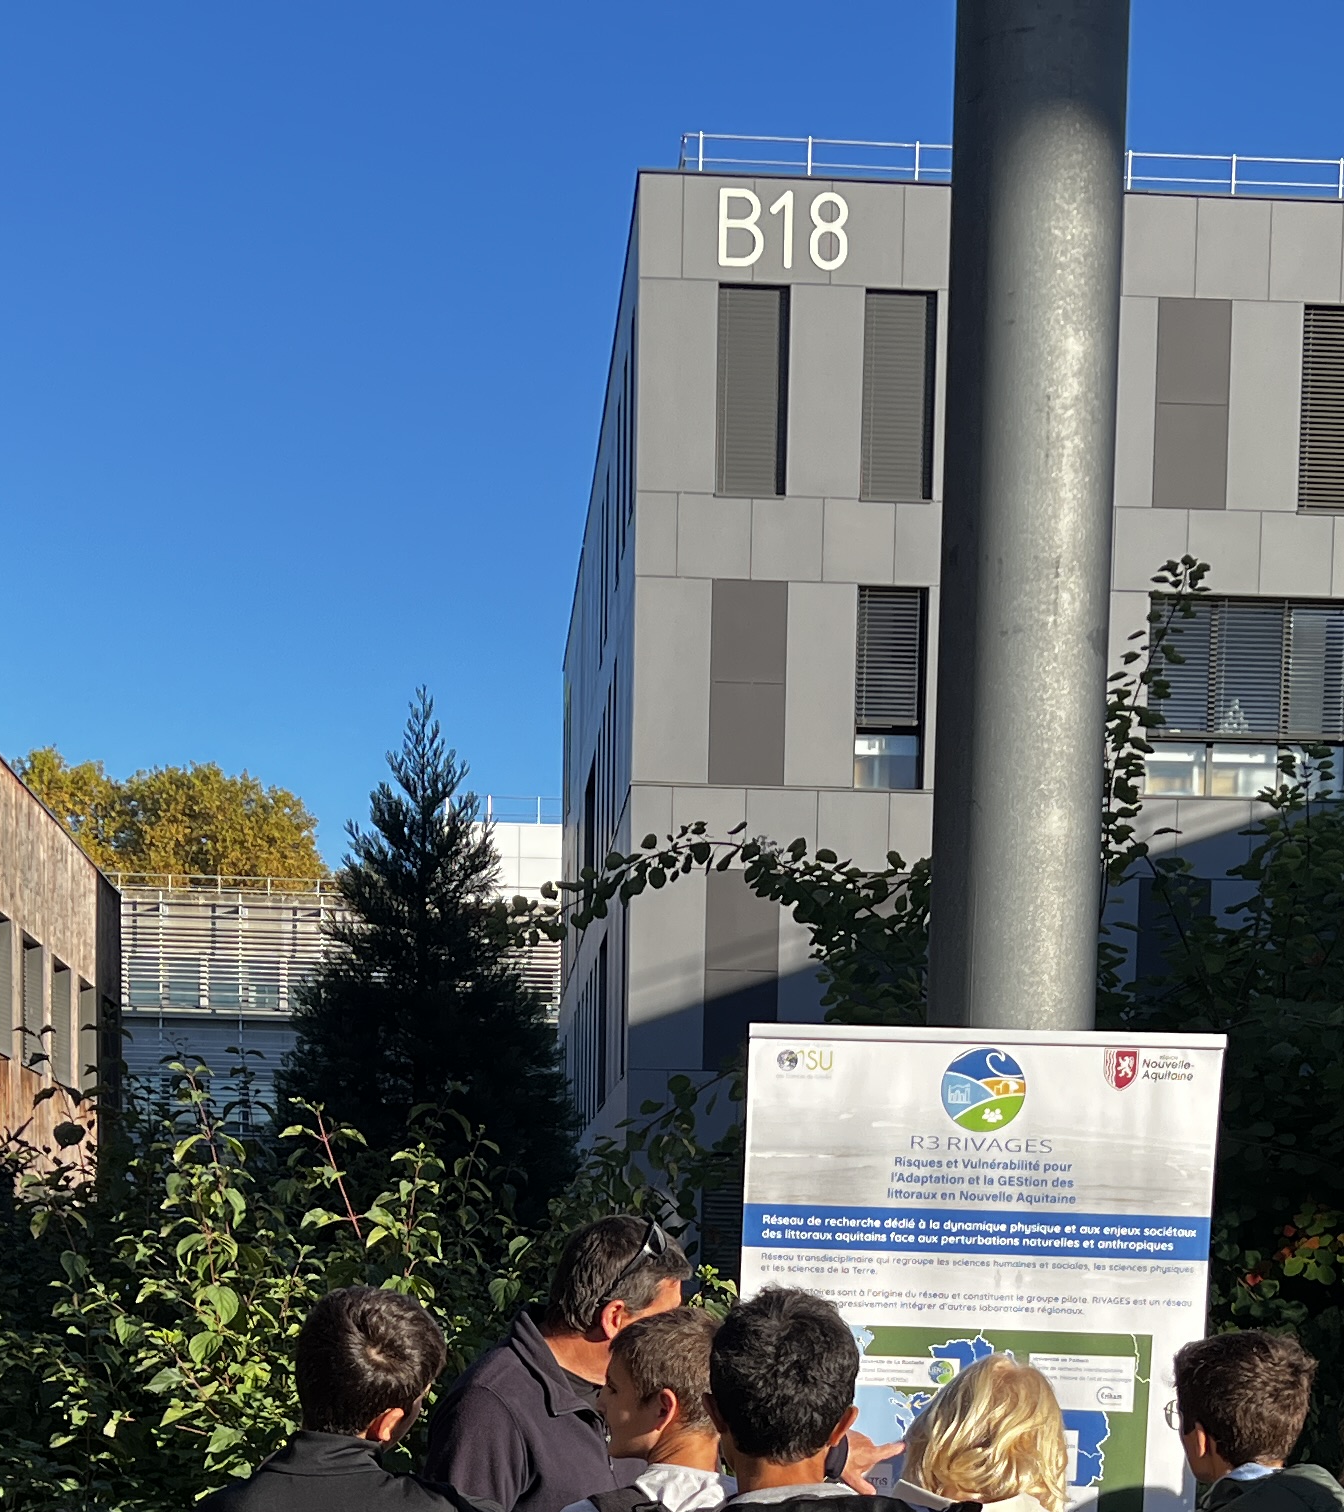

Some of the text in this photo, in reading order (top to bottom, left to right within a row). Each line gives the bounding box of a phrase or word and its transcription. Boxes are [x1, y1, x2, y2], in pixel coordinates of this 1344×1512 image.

[718, 187, 849, 271] B18
[1142, 1070, 1193, 1082] Aquitaine
[910, 1135, 1053, 1154] R3 RIVAGES
[894, 1156, 1072, 1173] Risques et Vulnérabilité pour
[891, 1172, 1073, 1188] l'Adaptation et la GEStion des
[886, 1188, 1076, 1206] littoraux en Nouvelle Aquitaine
[762, 1215, 1196, 1238] Réseau de recherche dédié à la dynamique physique et aux enjeux sociétaux
[761, 1229, 1174, 1253] des littoraux aquitains face aux perturbations naturelles et anthropiques
[760, 1252, 794, 1261] Réseau
[796, 1253, 873, 1265] transdisciplinaire
[876, 1256, 889, 1266] qui
[892, 1258, 934, 1268] regroupe
[936, 1257, 949, 1266] les
[952, 1258, 990, 1267] sciences
[993, 1259, 1036, 1268] humaines
[1039, 1260, 1048, 1269] et
[1093, 1262, 1106, 1270] les
[1108, 1262, 1147, 1271] sciences
[1150, 1263, 1193, 1275] physiques
[760, 1263, 769, 1271] et
[772, 1264, 784, 1272] les
[787, 1264, 824, 1273] sciences
[837, 1288, 856, 1296] sont
[905, 1290, 916, 1298] du
[919, 1290, 950, 1299] réseau
[952, 1291, 960, 1299] et
[963, 1292, 1014, 1301] constituent
[1016, 1293, 1024, 1301] le
[1026, 1295, 1059, 1304] groupe
[1092, 1295, 1130, 1304] RIVAGES
[1133, 1297, 1146, 1305] est
[1162, 1298, 1192, 1306] réseau
[900, 1301, 935, 1312] intégrer
[979, 1303, 1034, 1313] laboratoires
